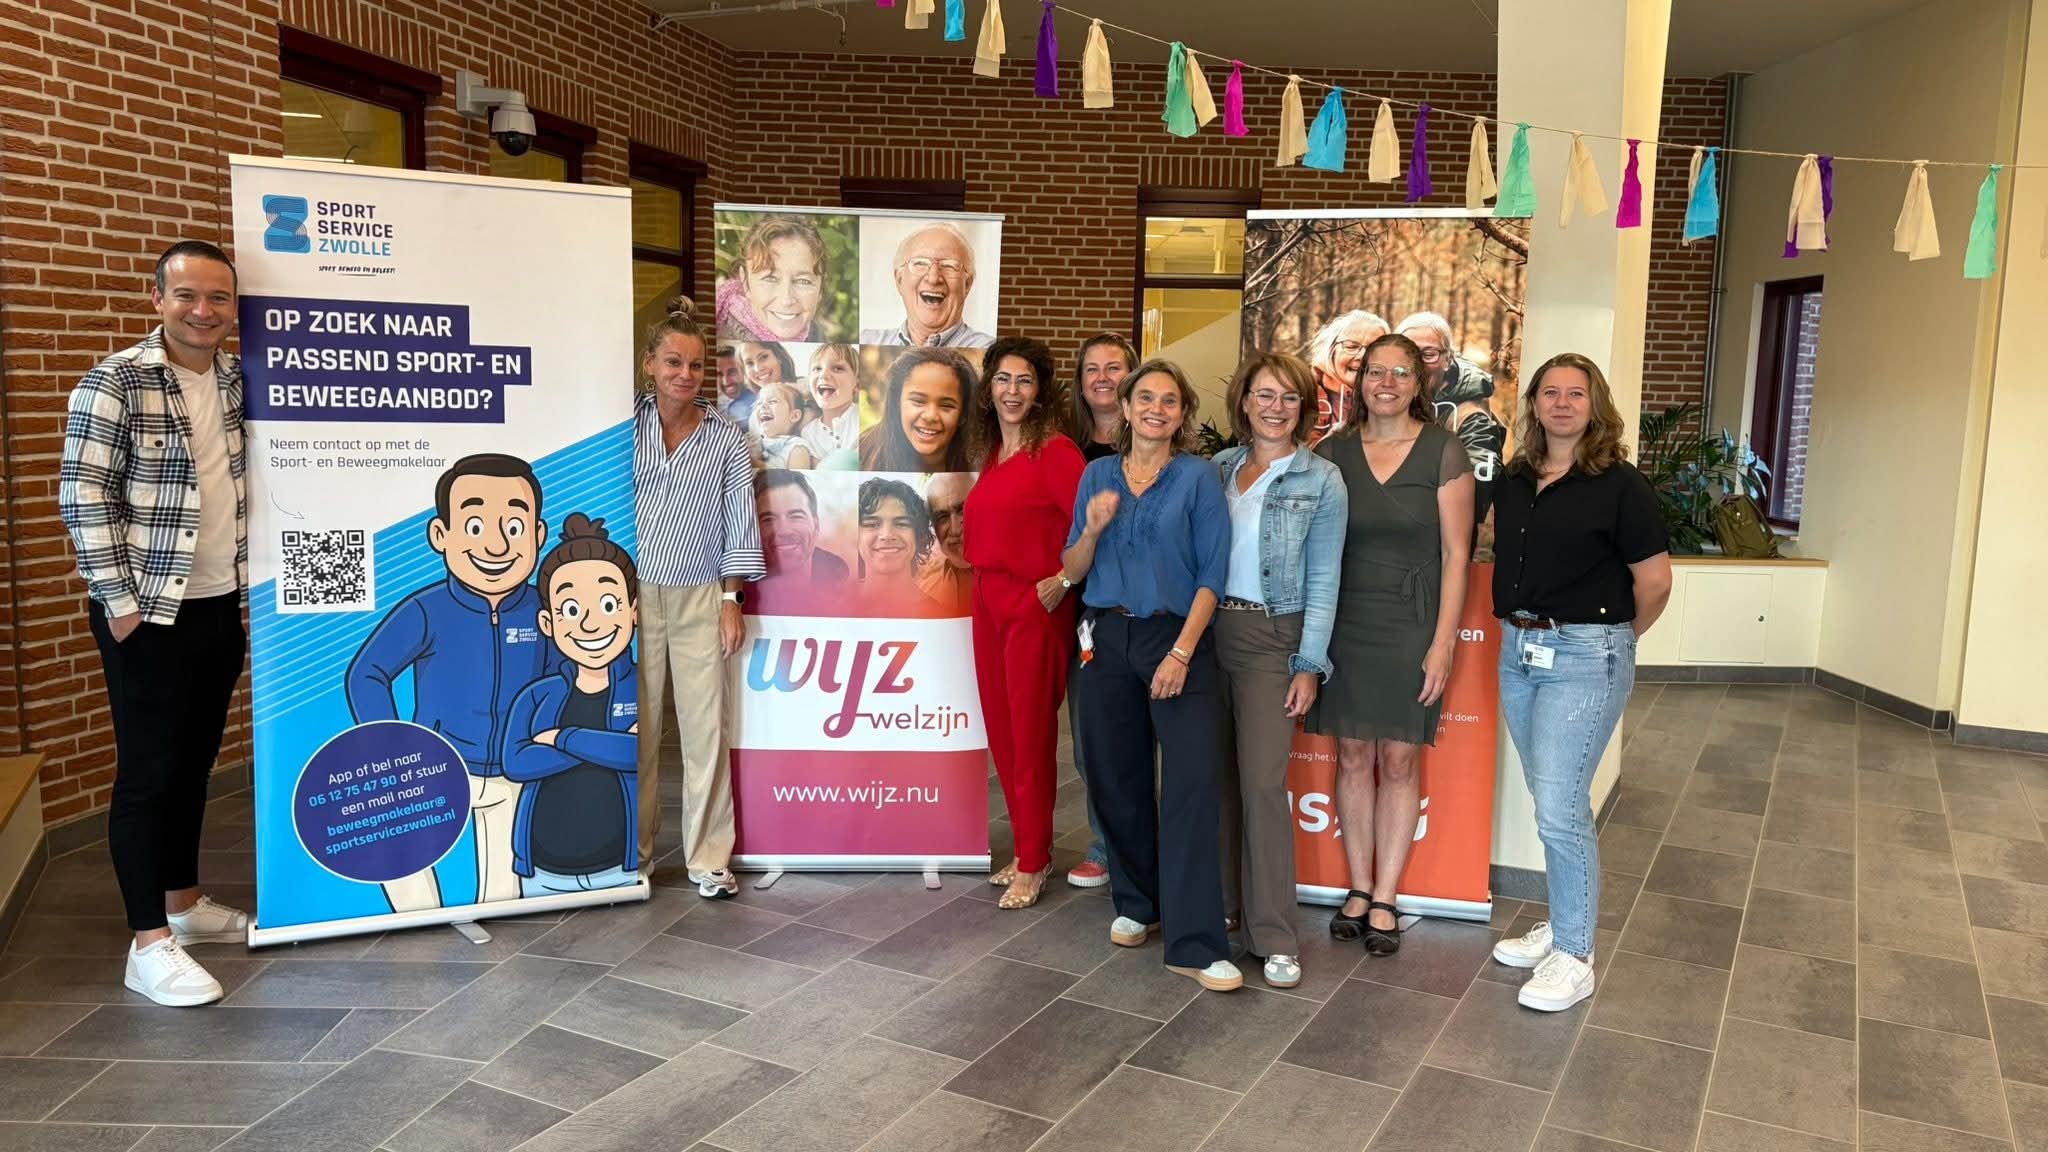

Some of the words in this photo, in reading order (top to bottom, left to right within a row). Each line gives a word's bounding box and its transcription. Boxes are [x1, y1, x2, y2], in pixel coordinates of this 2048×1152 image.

[317, 201, 376, 219] SPORT
[317, 220, 393, 239] SERVICE
[318, 239, 391, 256] ZWOLLE
[265, 309, 300, 332] OP
[308, 311, 377, 336] ZOEK
[384, 314, 452, 337] NAAR
[267, 347, 389, 372] PASSEND
[396, 350, 485, 375] SPORT-
[491, 354, 522, 376] EN
[268, 384, 493, 410] BEWEEGAANBOD?
[270, 439, 308, 450] Neem
[313, 439, 361, 450] contact
[365, 440, 381, 452] op
[386, 439, 410, 450] met
[414, 439, 430, 450] de
[270, 456, 312, 469] Sport-
[316, 458, 333, 468] en
[337, 456, 447, 469] Beweegmakelaar
[747, 637, 919, 738] wijz
[870, 704, 969, 737] welzijn
[1455, 713, 1479, 722] doen
[328, 771, 353, 785] App
[356, 764, 368, 777] of
[372, 758, 392, 774] bel
[394, 752, 422, 768] naar
[1314, 751, 1329, 761] het
[308, 794, 326, 807] 06
[328, 789, 343, 801] 12
[344, 784, 360, 797] 75
[363, 780, 377, 792] 47
[380, 774, 398, 787] 90
[400, 770, 413, 783] of
[416, 762, 448, 778] stuur
[773, 780, 939, 810] www.wijz.nu
[341, 803, 365, 816] een
[368, 792, 394, 808] mail
[398, 784, 425, 800] naar
[327, 795, 447, 837] beweegmakelaar@
[325, 808, 456, 855] sportservicezwolle.nl
